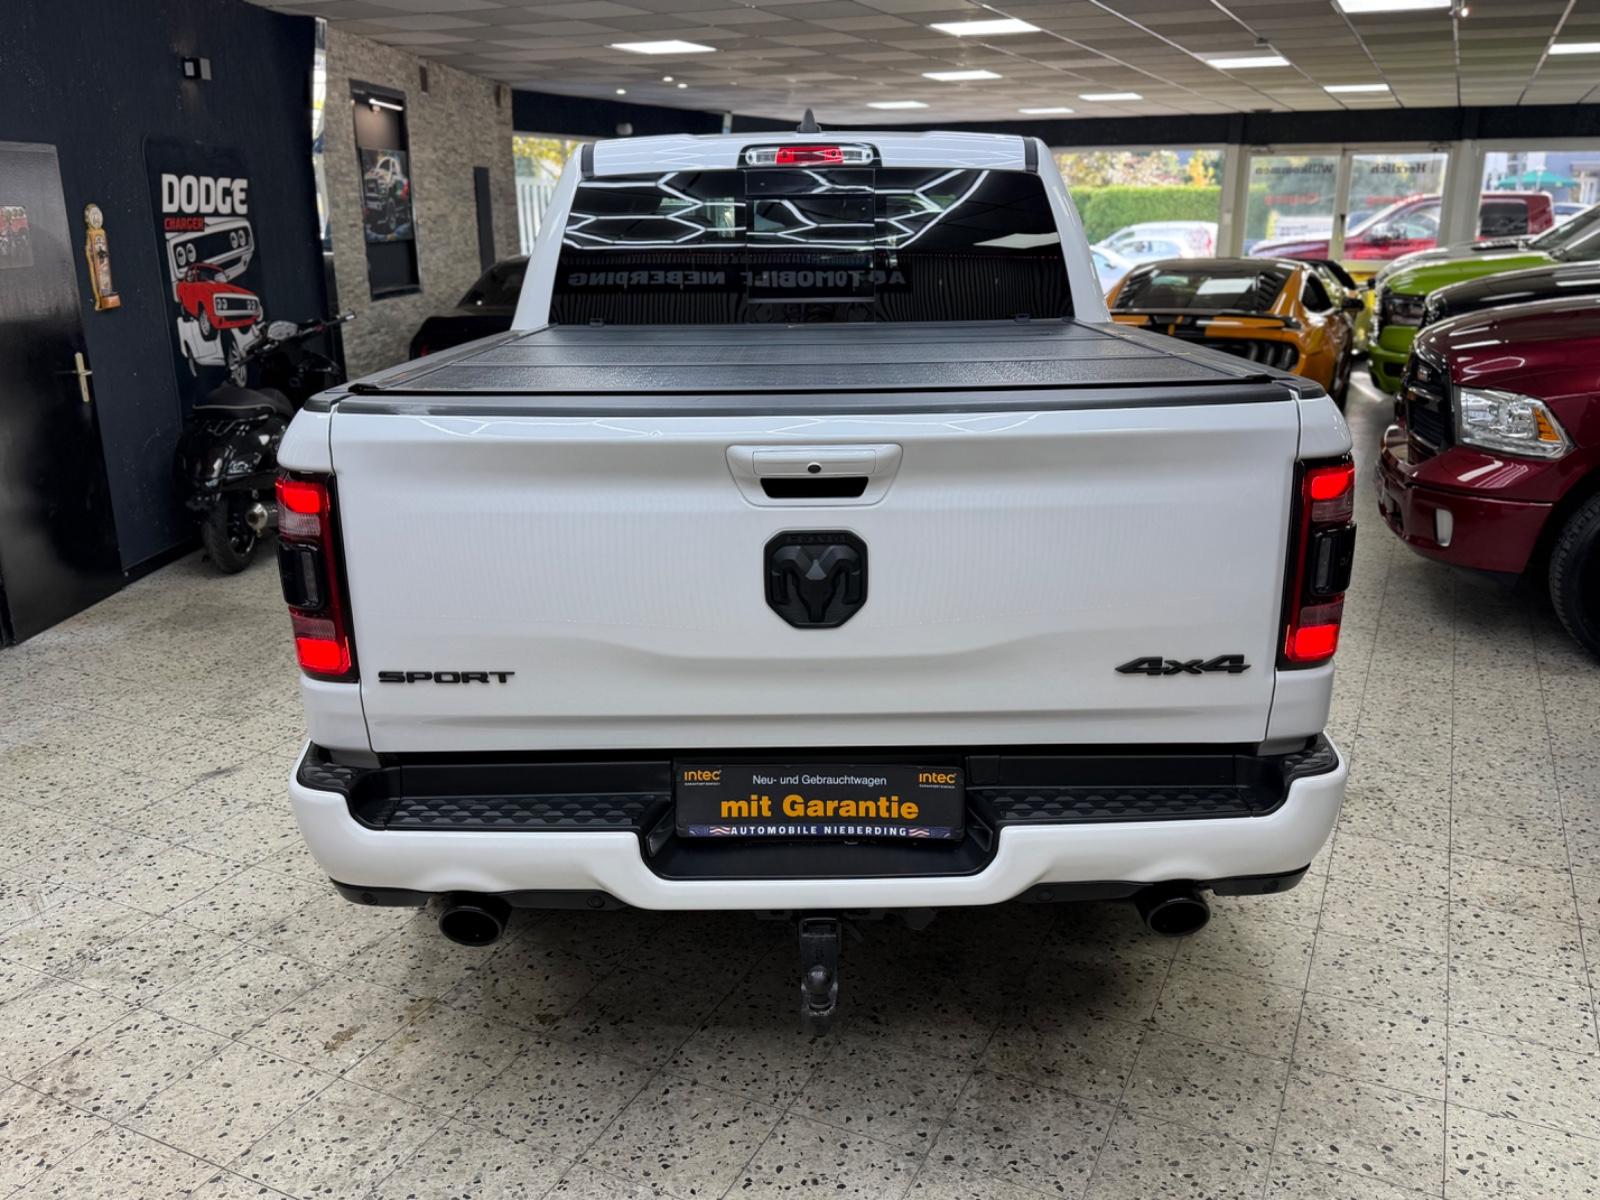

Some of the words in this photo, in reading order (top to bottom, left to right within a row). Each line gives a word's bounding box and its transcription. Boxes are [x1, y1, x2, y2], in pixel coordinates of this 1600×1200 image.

[161, 173, 248, 215] DODGE
[163, 217, 204, 231] CHARGER
[1114, 654, 1252, 676] 4x4
[378, 671, 515, 684] SPORT
[684, 770, 721, 781] intec
[752, 775, 777, 785] Neu-
[780, 775, 799, 785] und
[801, 775, 887, 787] Gebrauchtwagen
[919, 772, 956, 784] intec
[721, 794, 772, 818] mit
[782, 794, 919, 819] Garantie
[730, 825, 818, 835] AUTOMOBILE
[824, 825, 908, 836] NIEBERDING
